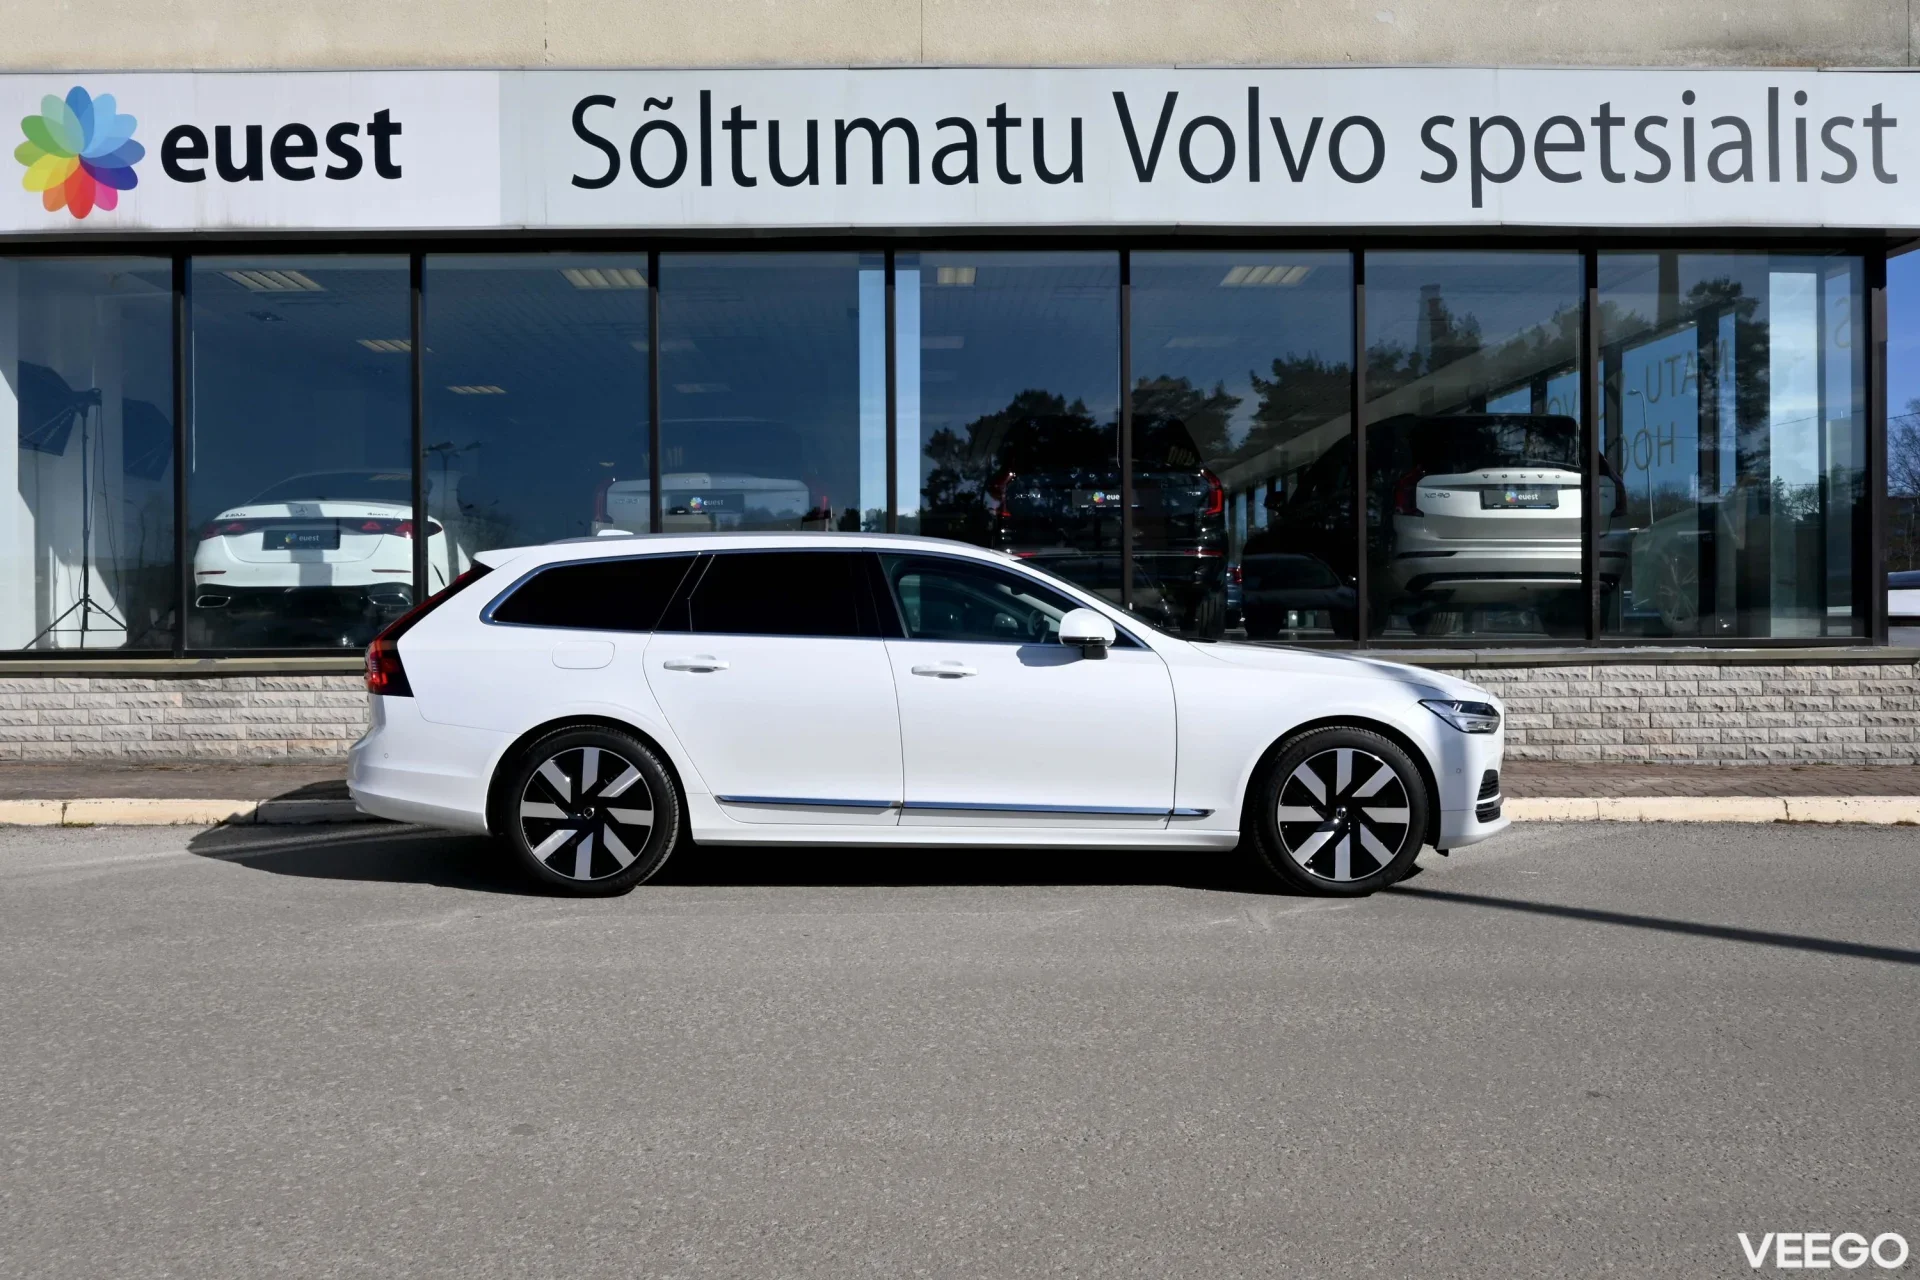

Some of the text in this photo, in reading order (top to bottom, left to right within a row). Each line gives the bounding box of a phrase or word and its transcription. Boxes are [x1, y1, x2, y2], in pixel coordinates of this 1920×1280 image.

[161, 109, 402, 183] euest
[572, 87, 1897, 208] Sõltumatu Volvo spetsialist
[1518, 494, 1538, 502] euest
[298, 534, 320, 543] euest
